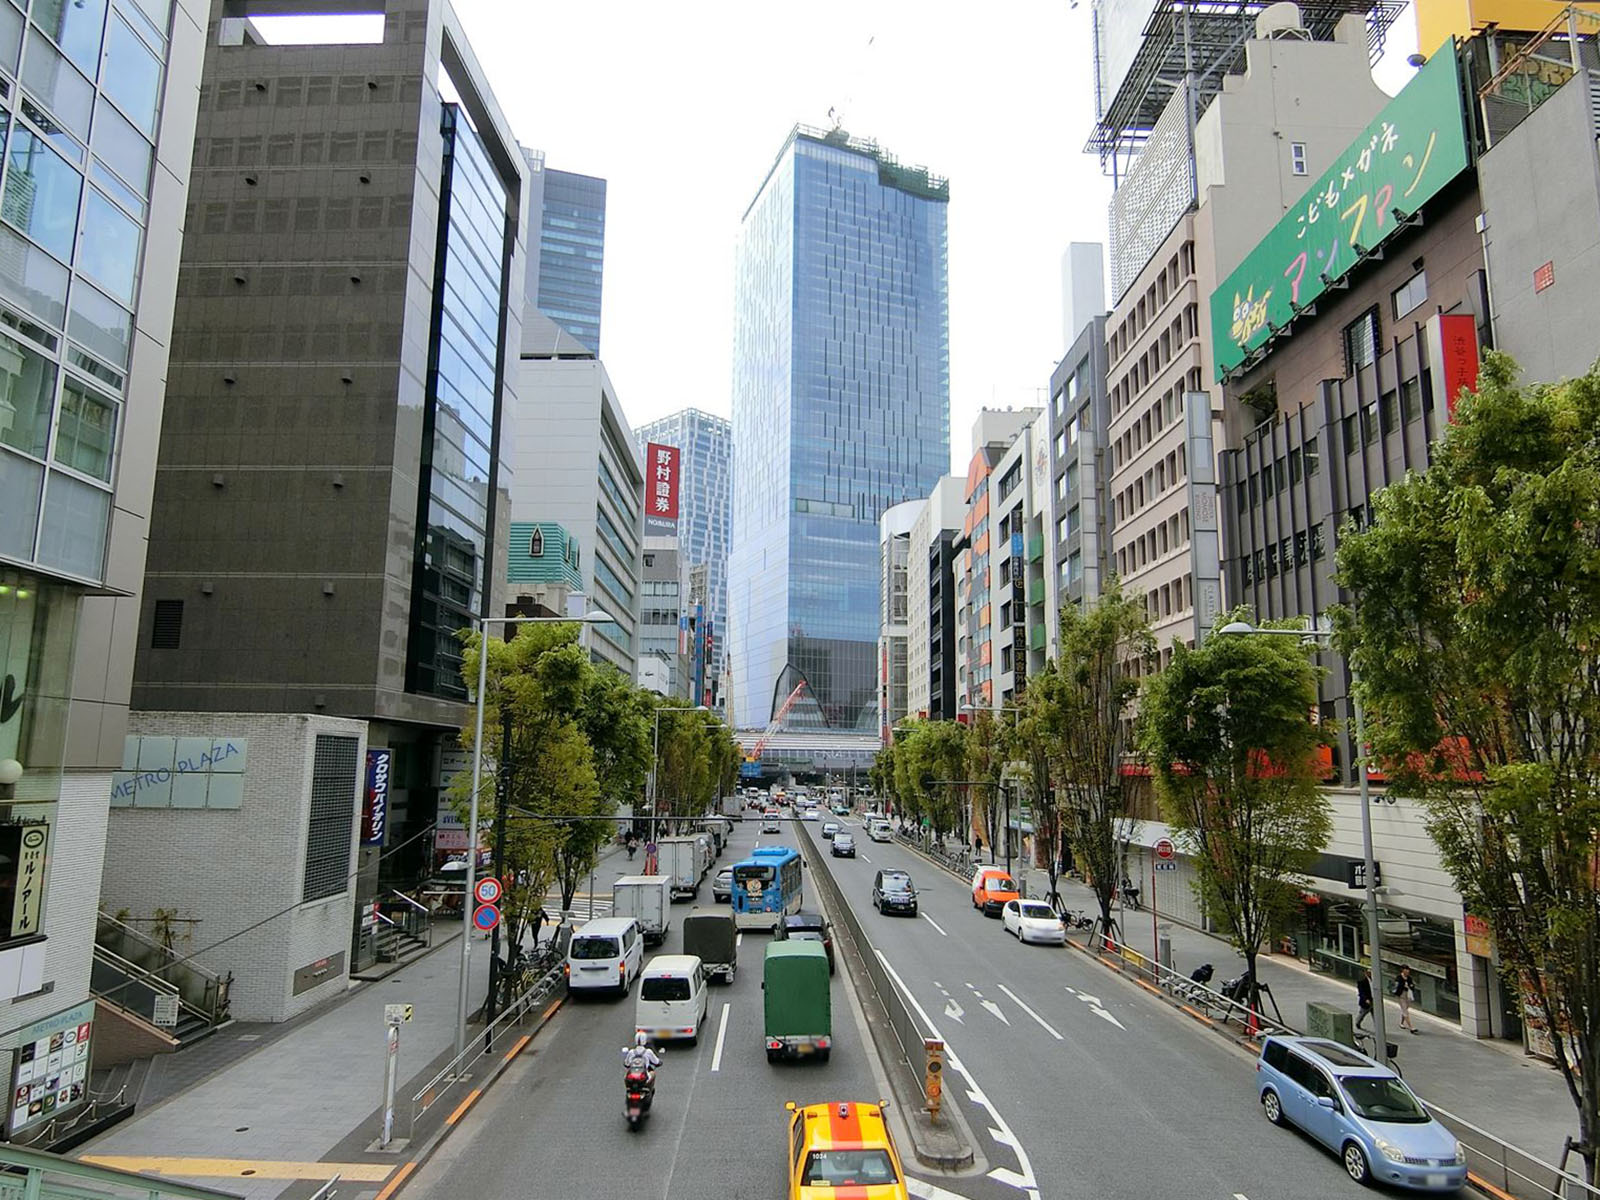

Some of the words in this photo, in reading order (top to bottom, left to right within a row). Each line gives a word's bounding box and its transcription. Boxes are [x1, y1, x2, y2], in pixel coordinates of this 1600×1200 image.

[178, 743, 239, 775] PLAZA
[19, 861, 36, 930] ルノアール
[481, 884, 496, 897] 50
